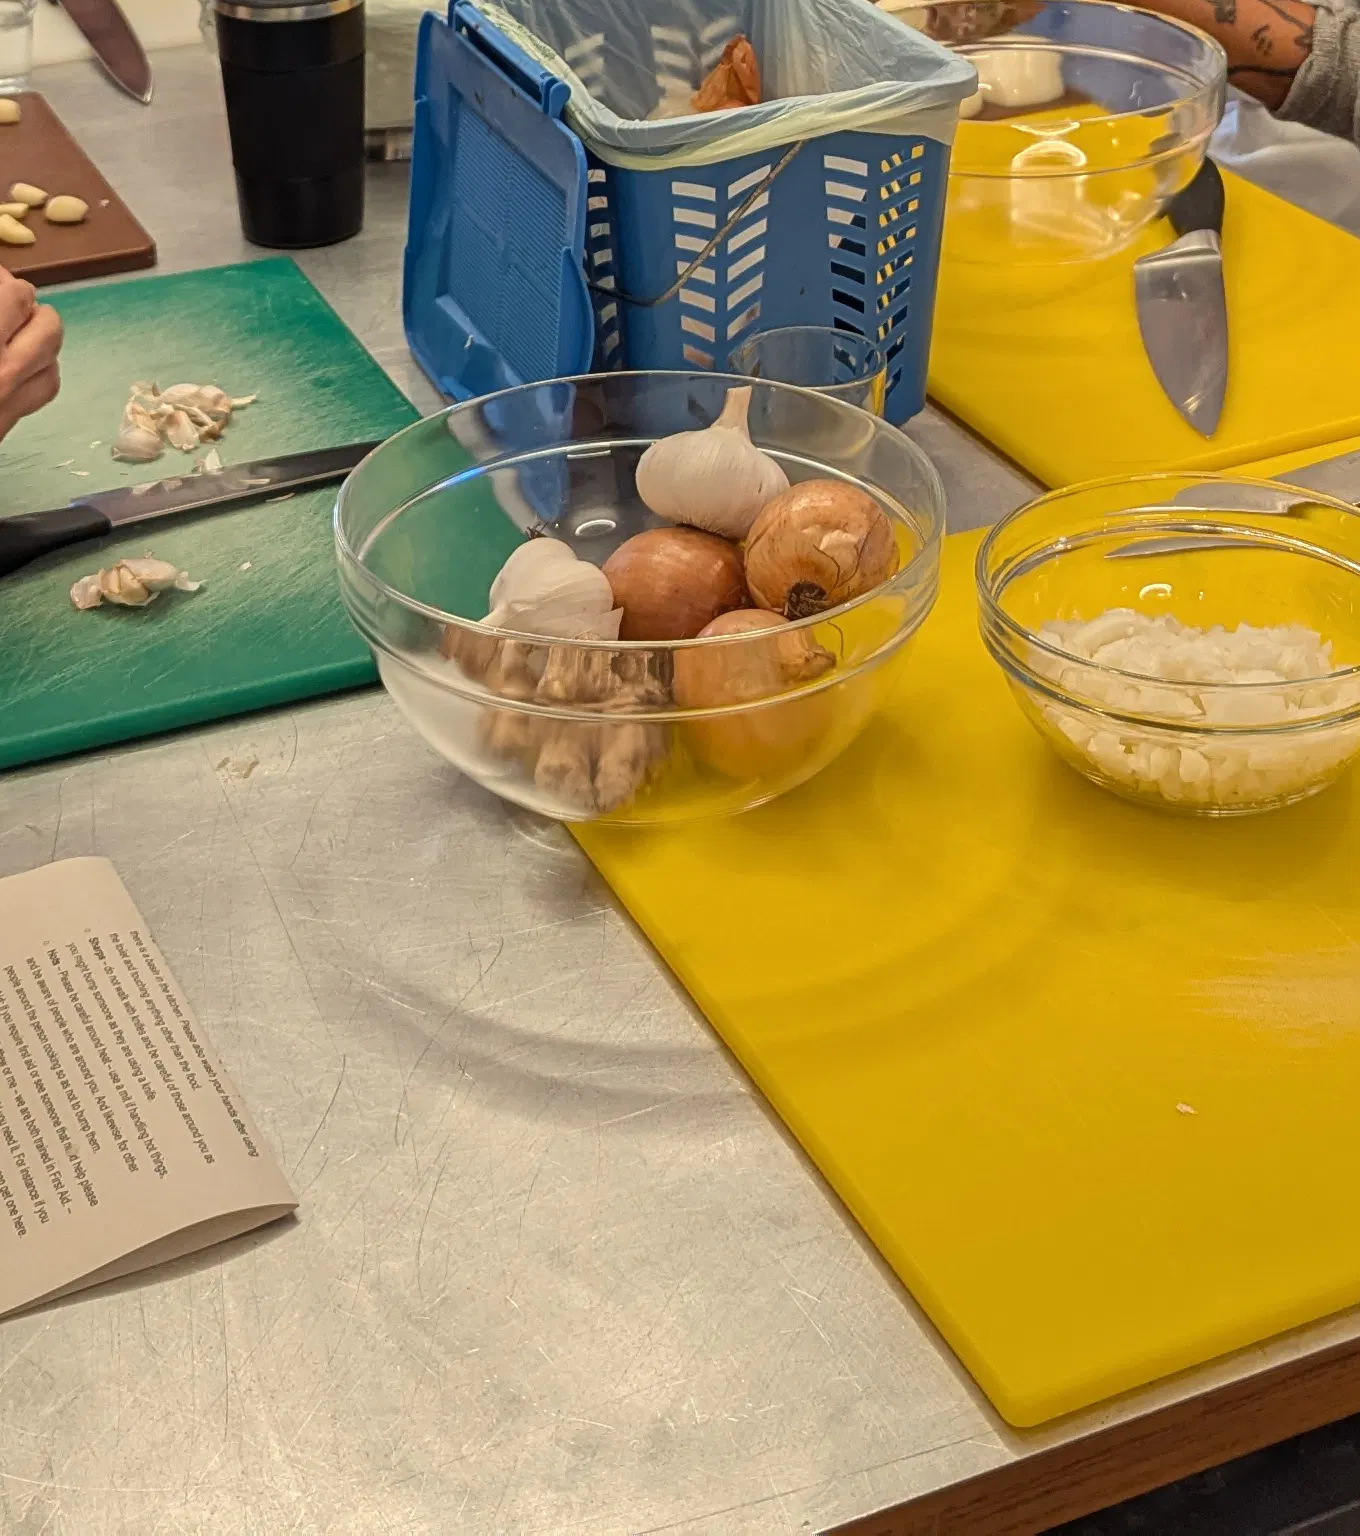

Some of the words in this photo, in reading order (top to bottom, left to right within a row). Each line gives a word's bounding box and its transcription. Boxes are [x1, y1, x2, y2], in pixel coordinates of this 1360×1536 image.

[110, 933, 120, 943] the
[130, 931, 143, 946] there
[26, 958, 40, 970] and
[124, 960, 138, 971] and
[4, 966, 21, 987] people
[32, 969, 42, 979] be
[37, 979, 52, 999] aware
[130, 972, 150, 998] touching
[159, 983, 169, 993] the
[16, 988, 34, 1010] around
[0, 1011, 12, 1023] you
[27, 1009, 37, 1021] the
[49, 1007, 67, 1028] people
[65, 943, 78, 955] you
[84, 972, 97, 990] bump
[93, 991, 113, 1020] someone
[108, 1021, 118, 1029] as
[113, 1030, 126, 1044] they
[121, 1046, 133, 1057] are
[128, 1058, 143, 1077] using
[145, 999, 165, 1026] anything
[8, 1024, 23, 1046] require
[30, 1021, 48, 1043] person
[62, 1028, 74, 1043] who
[161, 1027, 175, 1043] other
[180, 1020, 196, 1042] Please
[19, 1045, 31, 1059] first
[43, 1044, 61, 1070] cooking
[69, 1043, 80, 1055] are
[89, 937, 105, 960] Sharps
[104, 966, 114, 974] do
[109, 975, 121, 986] not
[115, 986, 129, 1001] walk
[124, 1001, 136, 1015] with
[141, 1036, 156, 1049] and
[149, 1049, 159, 1059] be
[154, 1060, 174, 1083] careful
[171, 1092, 187, 1111] those
[182, 1113, 203, 1138] around
[193, 1139, 209, 1153] you
[204, 1154, 215, 1163] as
[170, 1045, 184, 1060] than
[192, 1044, 205, 1058] also
[24, 1059, 37, 1070] aid
[58, 971, 74, 993] Please
[69, 992, 79, 1002] be
[74, 1003, 92, 1024] careful
[86, 1025, 104, 1048] around
[98, 1047, 112, 1064] heat
[109, 1070, 121, 1083] use
[128, 1107, 149, 1139] handling
[144, 1138, 157, 1153] hot
[75, 1055, 95, 1079] around
[179, 1061, 190, 1072] the
[202, 1059, 217, 1077] wash
[2, 1067, 12, 1075] or
[56, 1070, 66, 1079] so
[6, 1076, 17, 1088] me
[34, 1079, 46, 1093] see
[60, 1079, 70, 1089] as
[209, 1079, 225, 1094] your
[15, 1094, 25, 1107] we
[65, 1089, 78, 1102] not
[95, 1096, 110, 1111] And
[20, 1107, 31, 1120] are
[41, 1093, 61, 1127] someone
[71, 1101, 80, 1110] to
[221, 1096, 237, 1117] hands
[75, 1109, 90, 1131] bump
[103, 1110, 122, 1140] likewise
[233, 1119, 248, 1135] after
[26, 1119, 40, 1138] both
[56, 1127, 71, 1143] that
[34, 1137, 53, 1164] trained
[117, 1140, 128, 1152] for
[243, 1137, 259, 1157] using
[46, 1162, 56, 1173] in
[72, 1161, 86, 1179] help
[123, 1153, 138, 1172] other
[2, 1126, 18, 1146] need
[13, 1153, 26, 1167] For
[20, 1167, 39, 1200] instance
[34, 1207, 49, 1224] you
[49, 1171, 65, 1191] First
[78, 1180, 98, 1206] please
[6, 1200, 18, 1216] one
